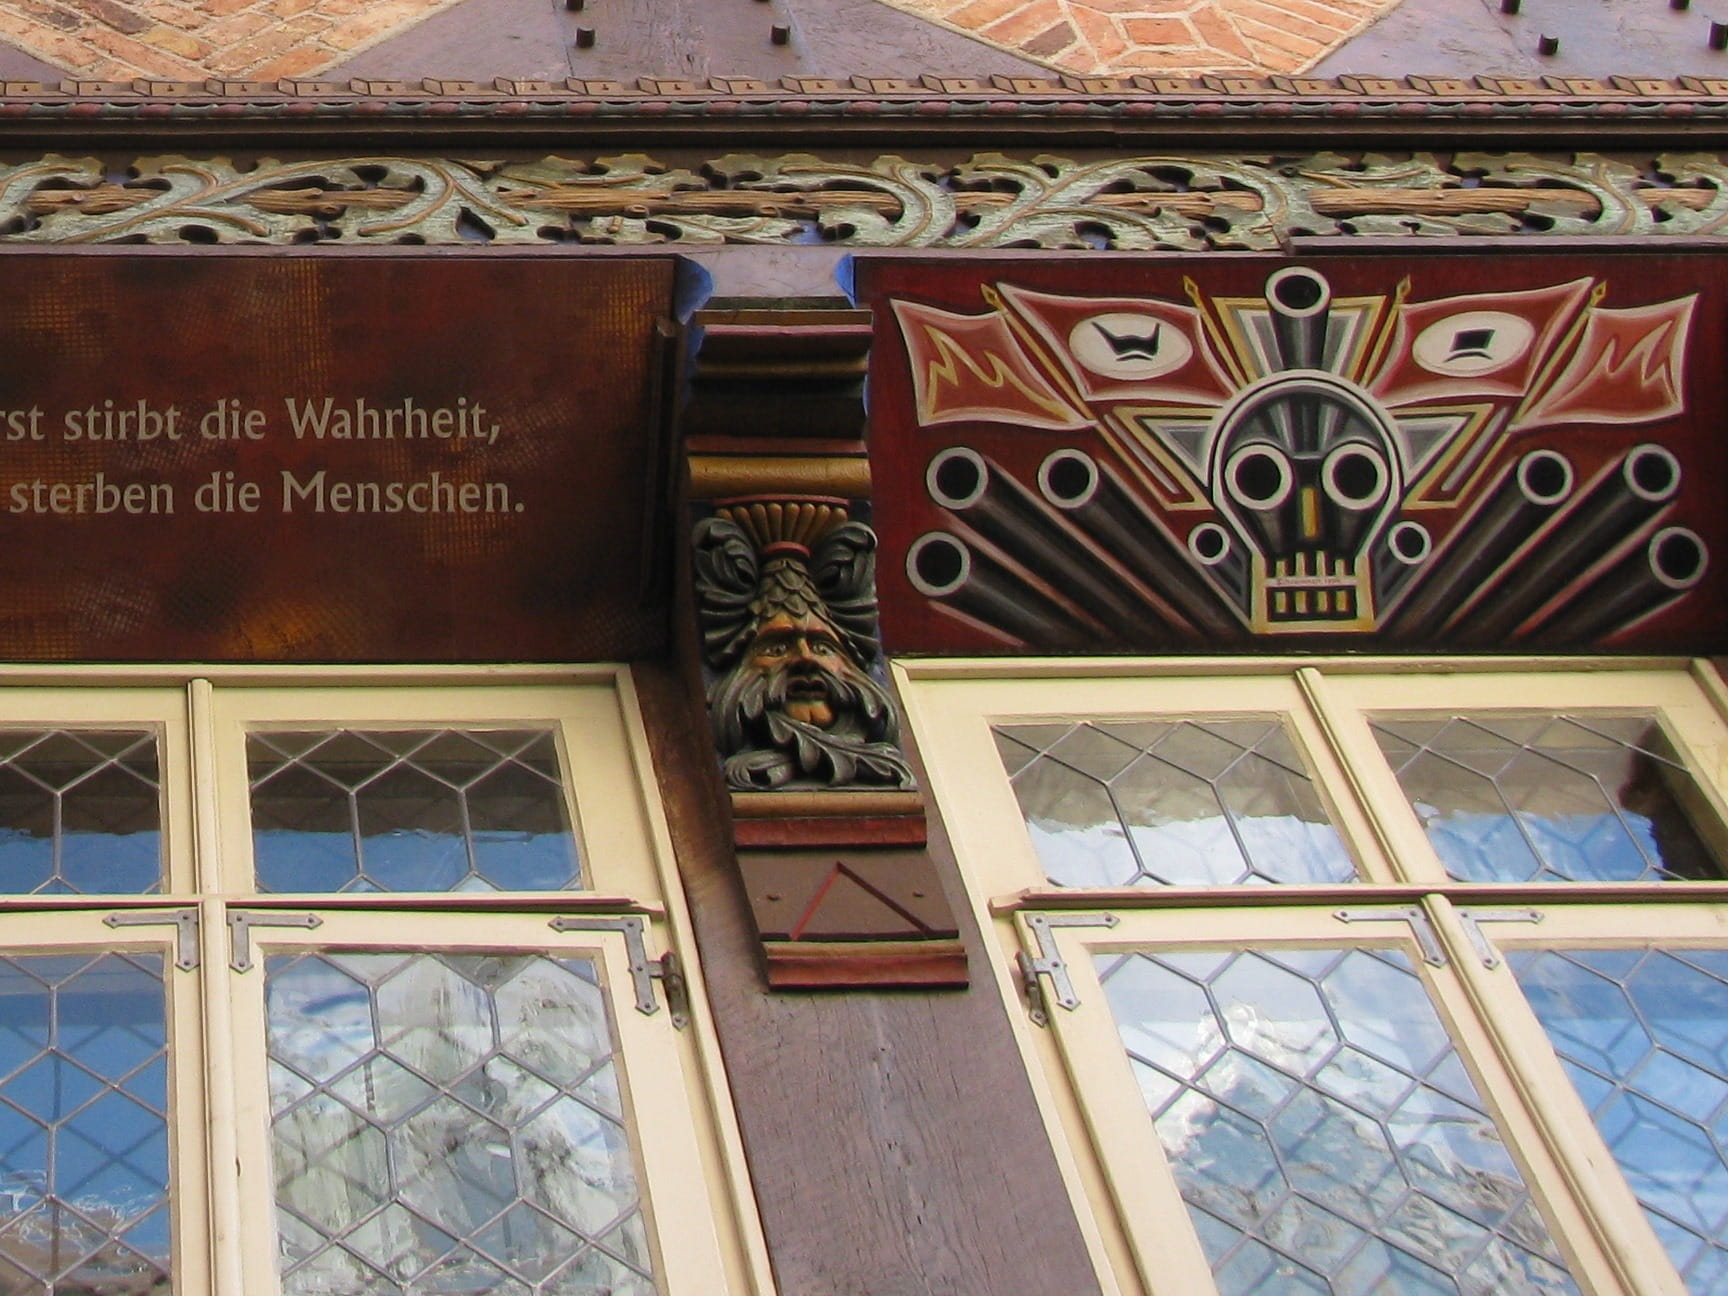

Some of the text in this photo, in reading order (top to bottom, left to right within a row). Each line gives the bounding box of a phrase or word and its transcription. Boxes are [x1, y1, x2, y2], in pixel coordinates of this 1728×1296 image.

[63, 399, 182, 441] stirbt
[200, 398, 266, 440] die
[284, 397, 500, 445] Wahrheit,
[9, 472, 174, 514] sterben
[194, 471, 261, 513] die
[281, 470, 524, 513] Menschen.
